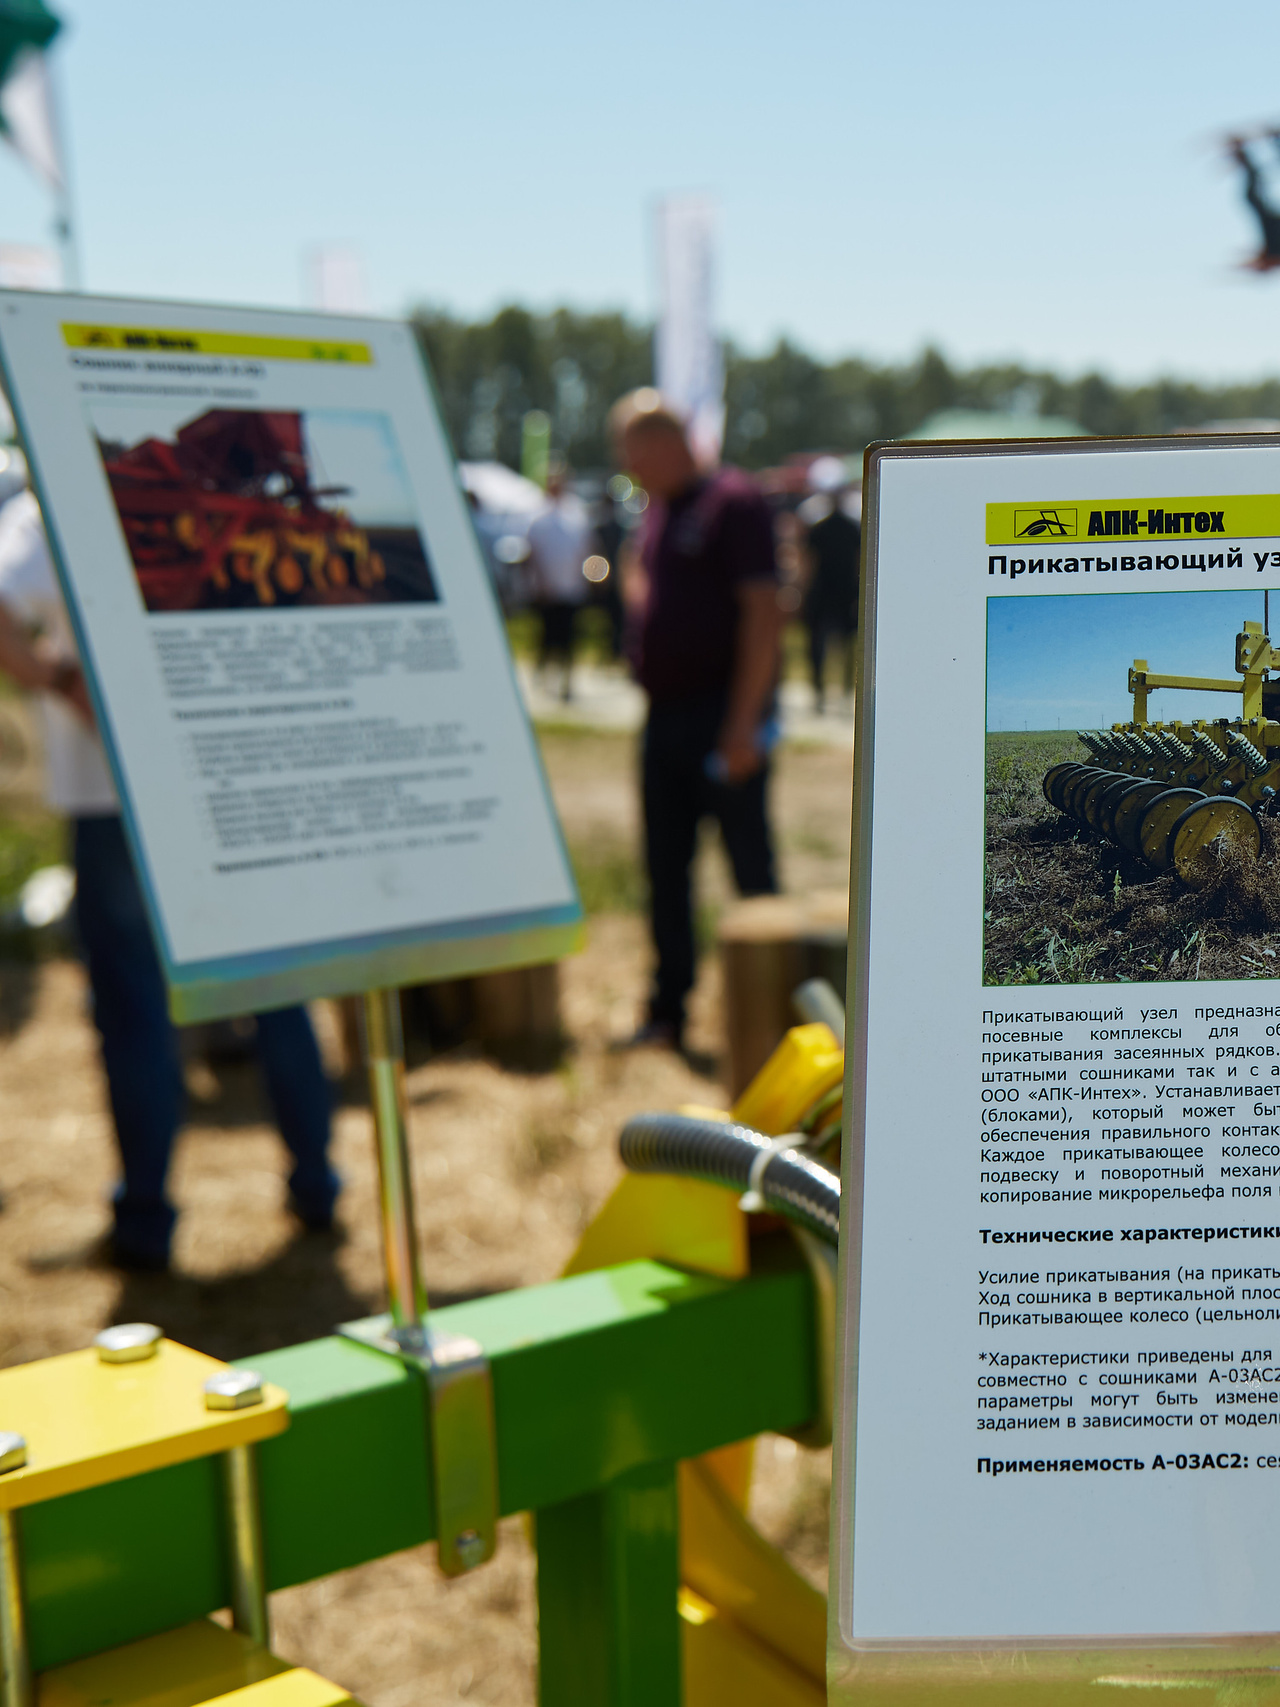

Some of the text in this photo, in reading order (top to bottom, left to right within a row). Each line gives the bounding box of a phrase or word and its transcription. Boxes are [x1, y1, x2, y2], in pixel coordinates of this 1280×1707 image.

[1086, 508, 1226, 537] АПК-Интех
[988, 546, 1243, 580] Прикатывающий
[982, 1006, 1124, 1027] Прикатывающий
[1139, 1008, 1178, 1024] узел
[981, 1030, 1064, 1044] посевные
[1090, 1027, 1182, 1041] комплексы
[1207, 1026, 1239, 1041] для
[981, 1049, 1104, 1067] прикатывания
[1113, 1047, 1205, 1061] засеянных
[1215, 1045, 1280, 1061] рядков.
[981, 1069, 1067, 1083] штатными
[1079, 1067, 1175, 1081] сошниками
[1186, 1066, 1216, 1078] так
[1227, 1065, 1237, 1078] и
[1249, 1065, 1259, 1077] с
[980, 1087, 1020, 1103] ООО
[1027, 1086, 1147, 1102] «АПК-Интех».
[981, 1106, 1073, 1126] (блоками),
[1092, 1103, 1164, 1123] который
[1182, 1105, 1236, 1118] может
[980, 1127, 1091, 1143] обеспечения
[1101, 1126, 1211, 1143] правильного
[980, 1148, 1045, 1165] Каждое
[1062, 1146, 1204, 1164] прикатывающее
[1221, 1144, 1280, 1158] колесо
[980, 1170, 1060, 1185] подвеску
[1074, 1169, 1085, 1181] и
[1101, 1163, 1204, 1183] поворотный
[980, 1189, 1093, 1206] копирование
[1098, 1183, 1225, 1204] микрорельефа
[1231, 1185, 1272, 1198] поля
[978, 1228, 1114, 1245] Технические
[978, 1270, 1040, 1285] Усилие
[1046, 1269, 1171, 1287] прикатывания
[1177, 1265, 1205, 1284] (на
[978, 1290, 1011, 1308] Ход
[1016, 1291, 1092, 1305] сошника
[1098, 1291, 1108, 1303] в
[1114, 1285, 1235, 1306] вертикальной
[978, 1311, 1124, 1329] Прикатывающее
[1129, 1310, 1189, 1323] колесо
[1137, 1350, 1234, 1367] приведены
[1240, 1349, 1273, 1365] для
[977, 1374, 1068, 1388] совместно
[1078, 1373, 1088, 1386] с
[1098, 1372, 1197, 1386] сошниками
[977, 1395, 1073, 1412] параметры
[1090, 1394, 1140, 1410] могут
[1156, 1389, 1199, 1406] быть
[976, 1416, 1060, 1432] заданием
[1067, 1416, 1077, 1429] в
[1082, 1414, 1193, 1429] зависимости
[1199, 1413, 1219, 1427] от
[977, 1457, 1146, 1477] Применяемость
[1151, 1452, 1249, 1471] А-03АС2:
